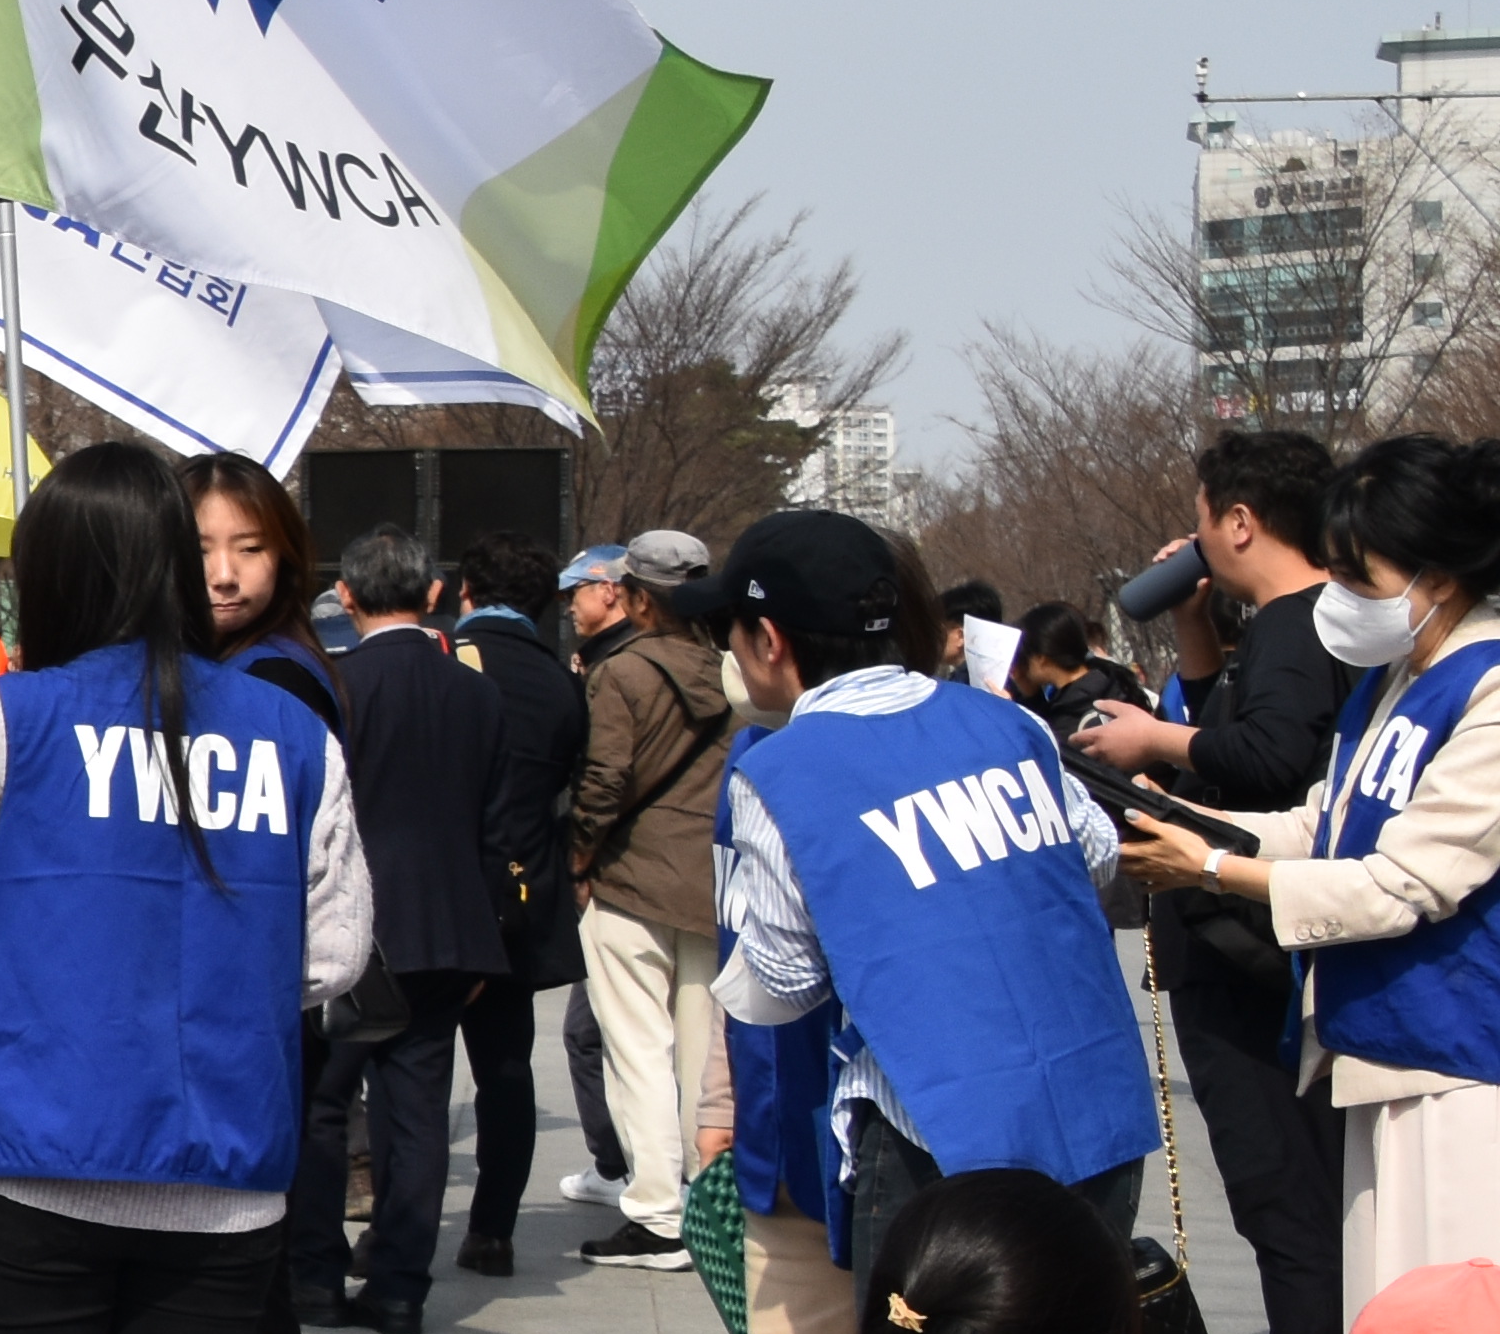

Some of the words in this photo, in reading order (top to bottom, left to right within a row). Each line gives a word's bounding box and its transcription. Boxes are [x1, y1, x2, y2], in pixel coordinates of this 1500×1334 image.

[73, 723, 290, 836] YWCA
[1360, 715, 1430, 811] CA
[859, 759, 1071, 890] YWCA
